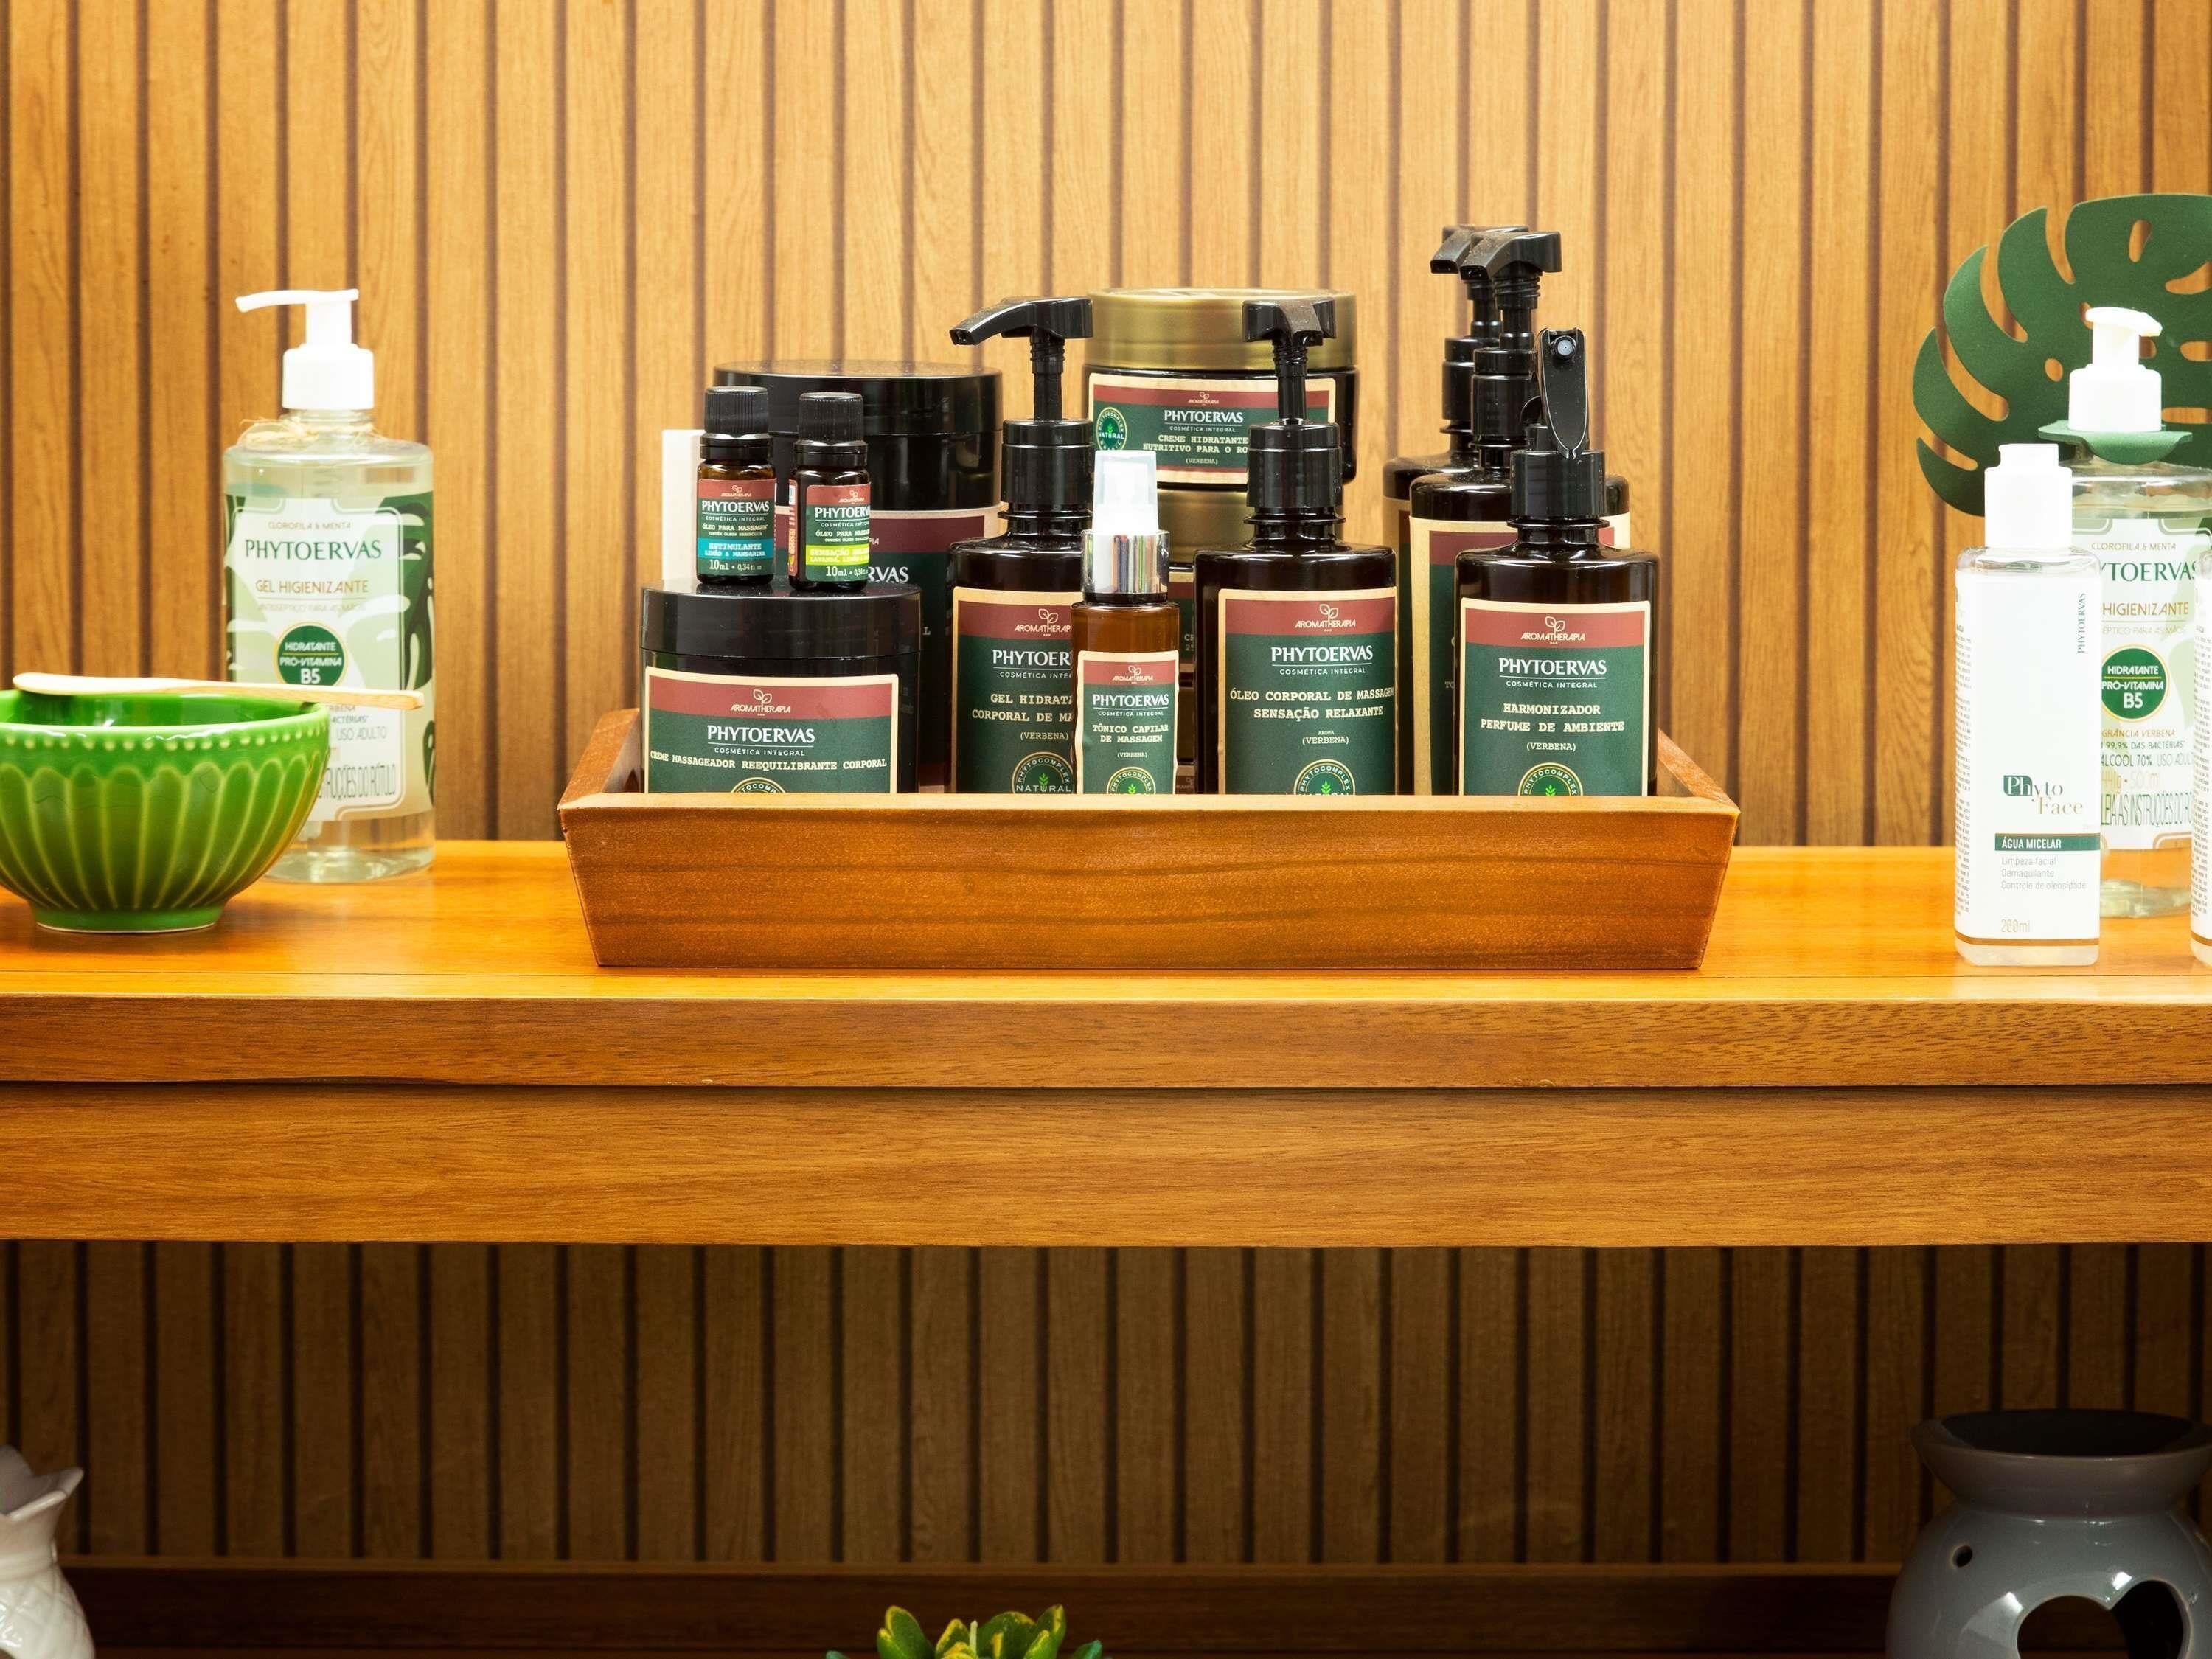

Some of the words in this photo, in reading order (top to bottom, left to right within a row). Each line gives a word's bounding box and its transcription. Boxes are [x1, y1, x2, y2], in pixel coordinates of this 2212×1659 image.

[1164, 410, 1243, 423] PHYTOERVAS
[1158, 434, 1186, 442] CREME
[1191, 435, 1249, 445] HIDRATANTE
[1143, 442, 1192, 453] NUTRITIVO
[1197, 445, 1220, 453] PARA
[701, 501, 770, 512] PHYTOERVAS
[268, 521, 312, 530] CLOROFILA
[322, 521, 352, 530] MENTA
[702, 523, 715, 531] ÓLEO
[245, 539, 382, 561] PHYTOERVAS
[2091, 542, 2139, 551] CLOROFILA
[2149, 542, 2177, 550] MENTA
[709, 560, 729, 570] 10ml
[826, 566, 847, 577] 10ml
[255, 580, 275, 594] GEL
[279, 580, 369, 594] HIGIENIZANTE
[2102, 602, 2189, 616] HIGIENIZANTE
[1295, 619, 1356, 628] AROMATHERAPIA
[2077, 592, 2086, 653] PHYTOERVAS
[1520, 632, 1585, 641] AROMATHERAPIA
[284, 641, 336, 652] HIDRATANTE
[992, 650, 1073, 667] PHYTOER
[1270, 645, 1374, 662] PHYTOERVAS
[1279, 667, 1328, 675] COSMÉTICA
[1498, 658, 1607, 676] PHYTOERVAS
[2107, 665, 2159, 675] HIDRATANTE
[300, 668, 321, 684] B5
[1506, 680, 1554, 689] COSMÉTICA
[2101, 680, 2164, 690] PRÓ-VITAMINA
[990, 694, 1013, 704] GEL
[1230, 688, 1259, 700] ÓLEO
[1265, 691, 1332, 701] CORPORAL
[1337, 691, 1352, 700] DE
[1092, 694, 1169, 707] PHYTOERVAS
[2124, 692, 2143, 709] B5
[730, 703, 791, 714] AROMATHERAPIA
[1253, 707, 1320, 722] SENSAÇÃO
[1326, 706, 1383, 719] RELAXANTE
[1503, 703, 1601, 715] HARMONIZADOR
[972, 709, 1030, 722] CORPORAL
[1037, 712, 1053, 722] DE
[1092, 723, 1127, 734] TÔNICO
[1132, 724, 1169, 734] CAPILAR
[1481, 718, 1531, 732] PERFUME
[1538, 722, 1556, 733] DE
[1563, 721, 1625, 733] AMBIENTE
[357, 726, 388, 740] ADULTO
[707, 725, 815, 743] PHYTOERVAS
[1020, 731, 1068, 740] (VERBENA)
[2142, 728, 2176, 737] VERBENA
[1117, 735, 1163, 743] MASSAGEM
[1302, 736, 1349, 745] (VERBENA)
[1526, 741, 1576, 752] (VERBENA)
[2131, 741, 2145, 749] DAS
[714, 747, 761, 756] COSMÉTICA
[650, 750, 669, 762] CREME
[672, 754, 736, 768] MASSAGEADOR
[742, 760, 838, 771] REEQUILIBRANTE
[843, 759, 887, 769] CORPORAL
[2137, 754, 2152, 766] 70%
[2157, 754, 2173, 766] USO
[1018, 757, 1070, 784] PHYTOCOMPLEX
[1300, 765, 1351, 792] PHYTOCOMPLEX
[1524, 769, 1577, 795] PHYTOCOMPLEX
[2006, 776, 2064, 797] Phyto
[2031, 796, 2083, 815] Face
[2001, 836, 2024, 849] ÁGUA
[2026, 838, 2062, 849] MICELAR
[2001, 856, 2033, 867] Limpeza
[2035, 856, 2056, 866] facial
[2001, 869, 2055, 879] Demaquilante
[2001, 880, 2034, 890] Controle
[2035, 880, 2045, 890] de
[2046, 880, 2087, 891] oleosidade
